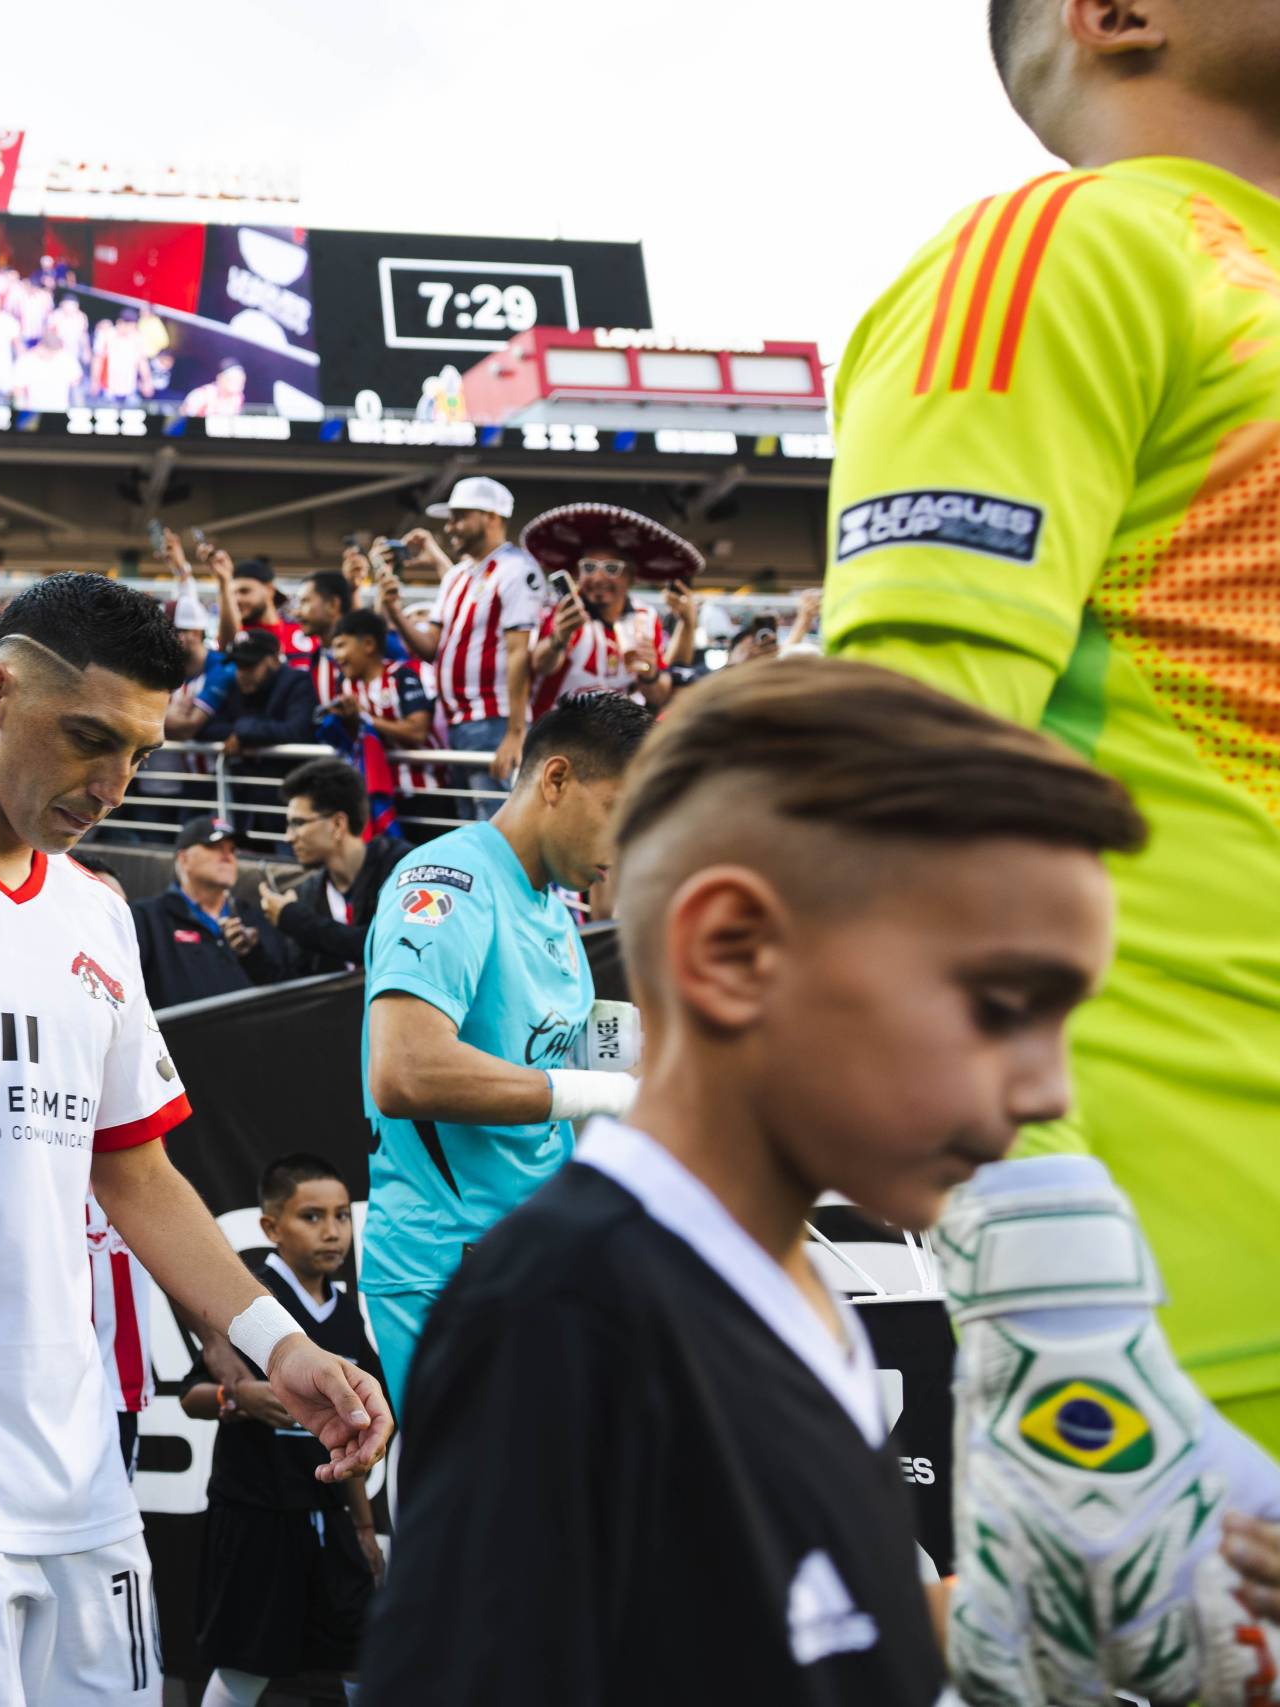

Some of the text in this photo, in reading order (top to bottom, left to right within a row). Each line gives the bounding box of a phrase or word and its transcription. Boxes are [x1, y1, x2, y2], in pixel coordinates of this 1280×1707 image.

[418, 282, 538, 330] 7:29
[870, 516, 942, 542] CUP
[871, 495, 1035, 535] LEAGUES
[412, 867, 471, 883] LEAGUES
[597, 1016, 619, 1059] RANGEL
